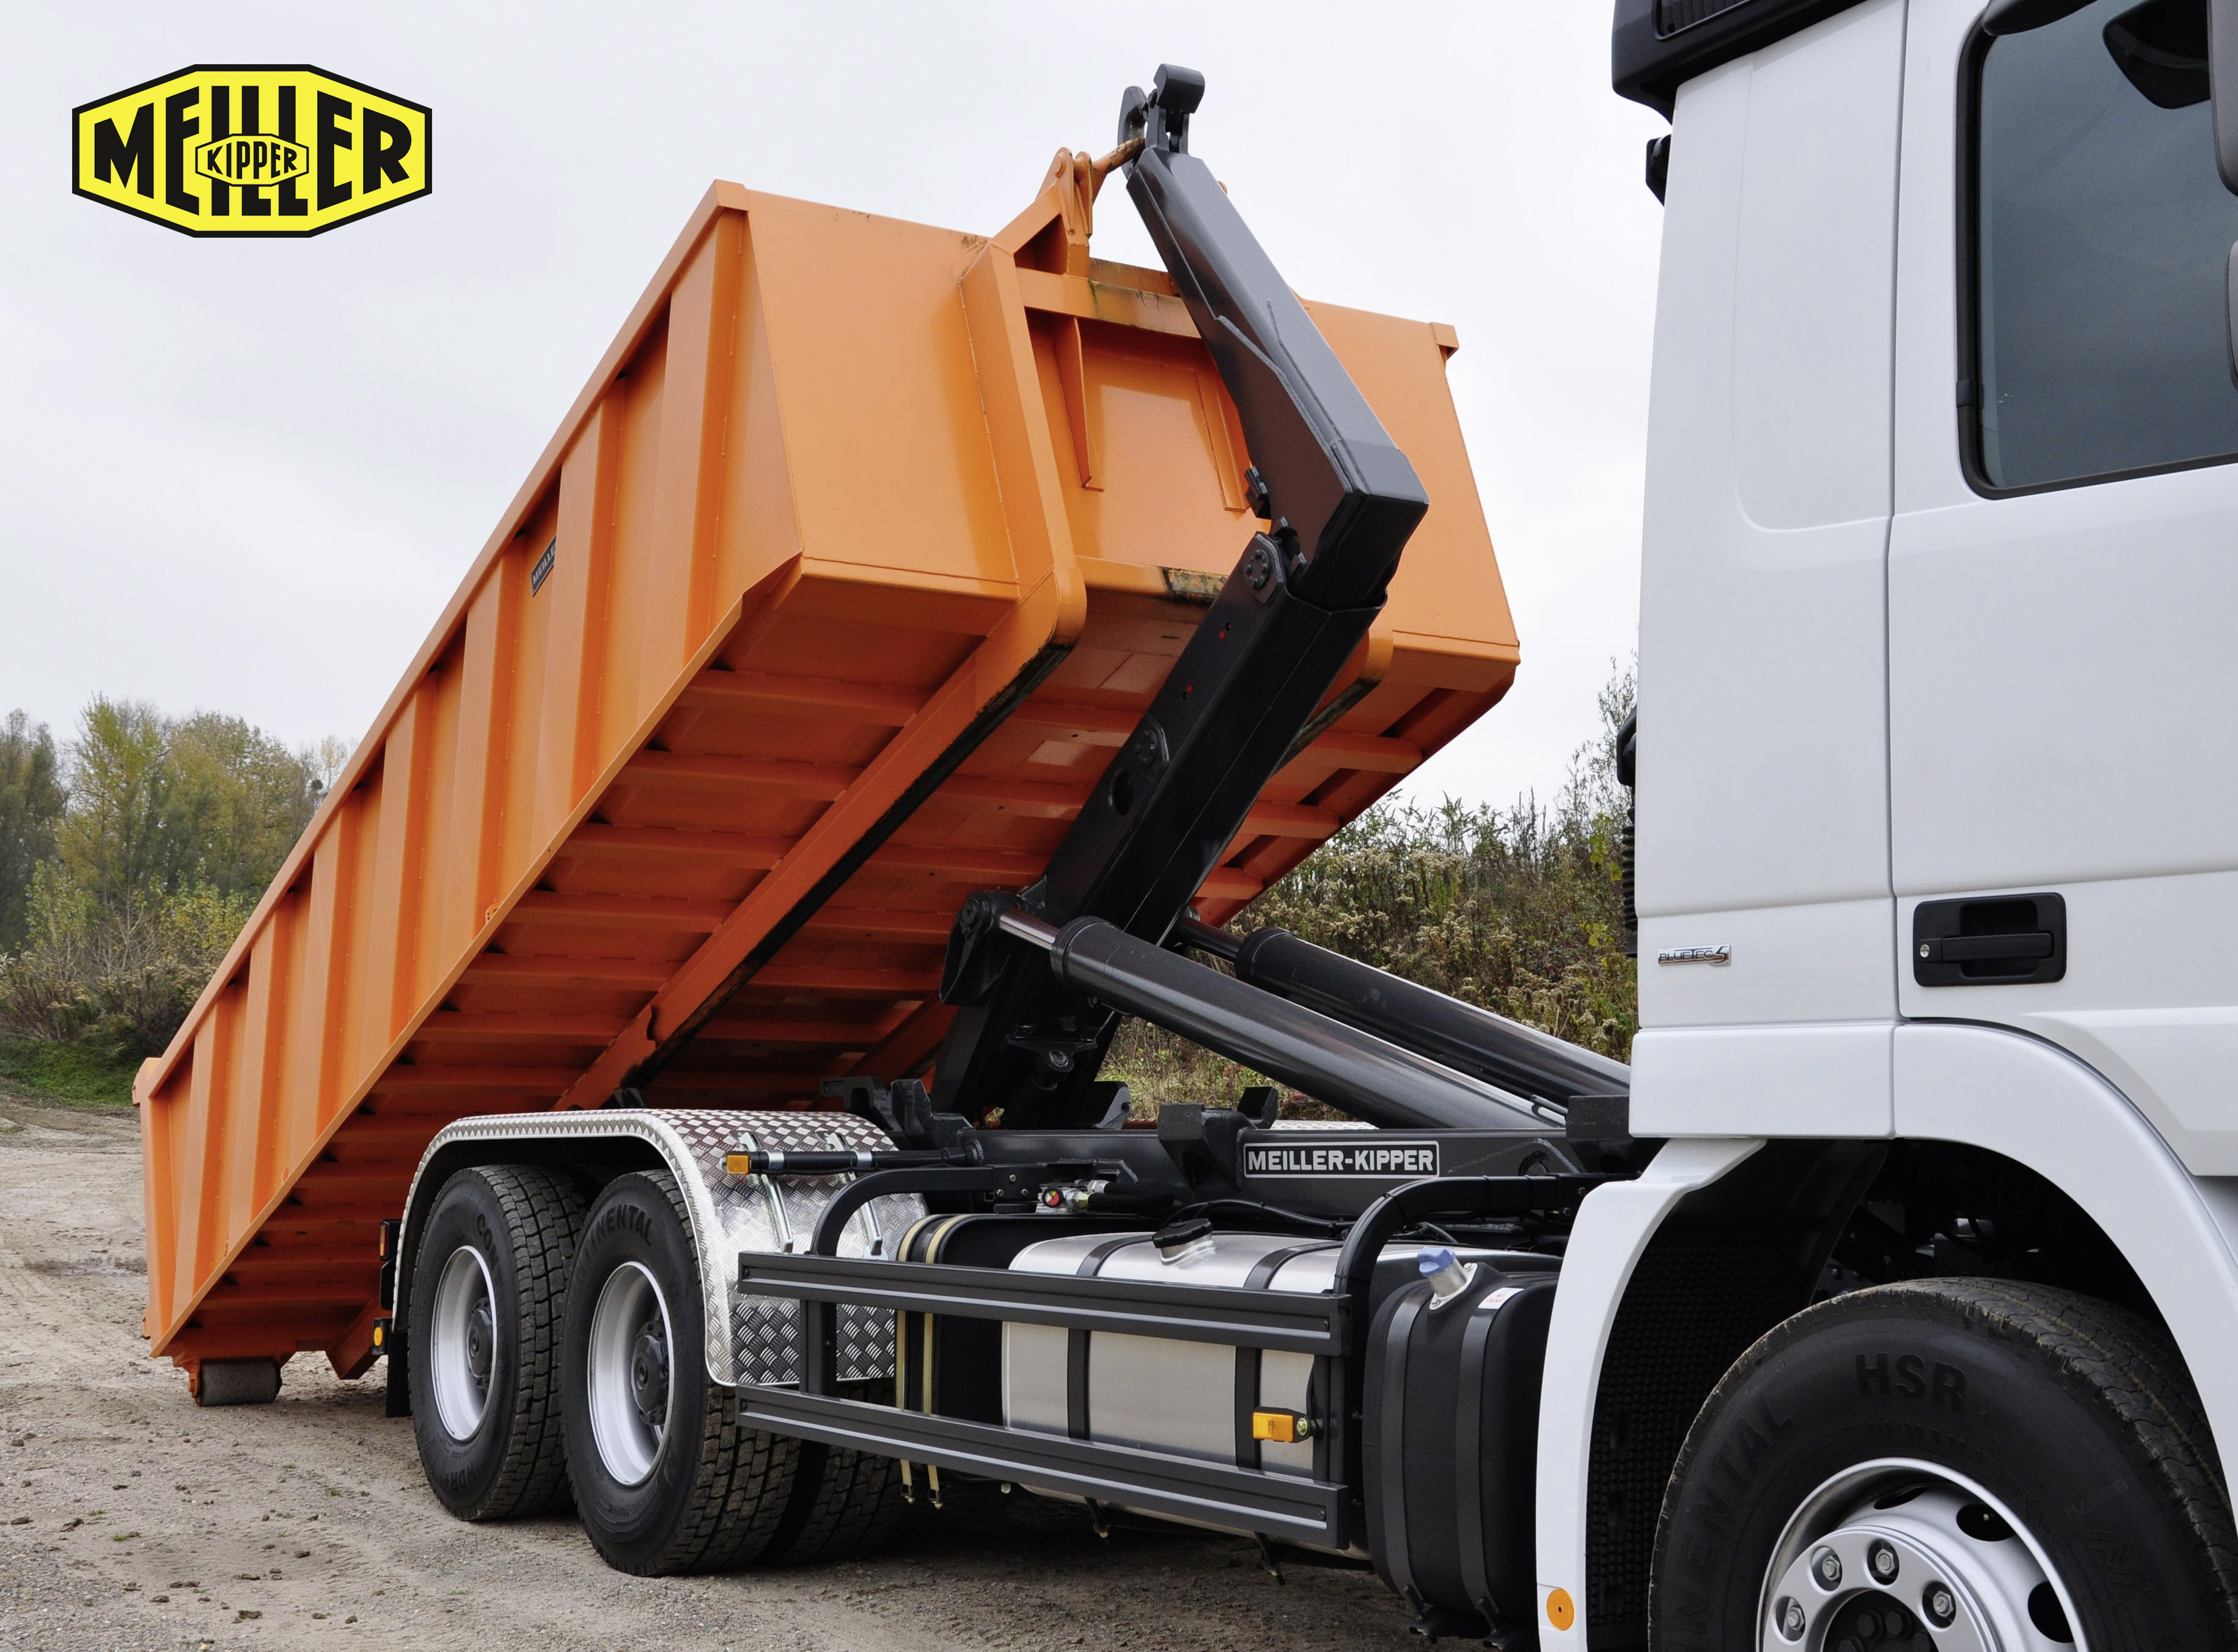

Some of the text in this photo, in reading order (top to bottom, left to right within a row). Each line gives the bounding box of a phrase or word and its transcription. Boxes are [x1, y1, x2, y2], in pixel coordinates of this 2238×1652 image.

[1659, 947, 1713, 961] BLUETEC
[1248, 1150, 1434, 1171] MEILLER-KIPPER
[1854, 1352, 1968, 1414] HSR
